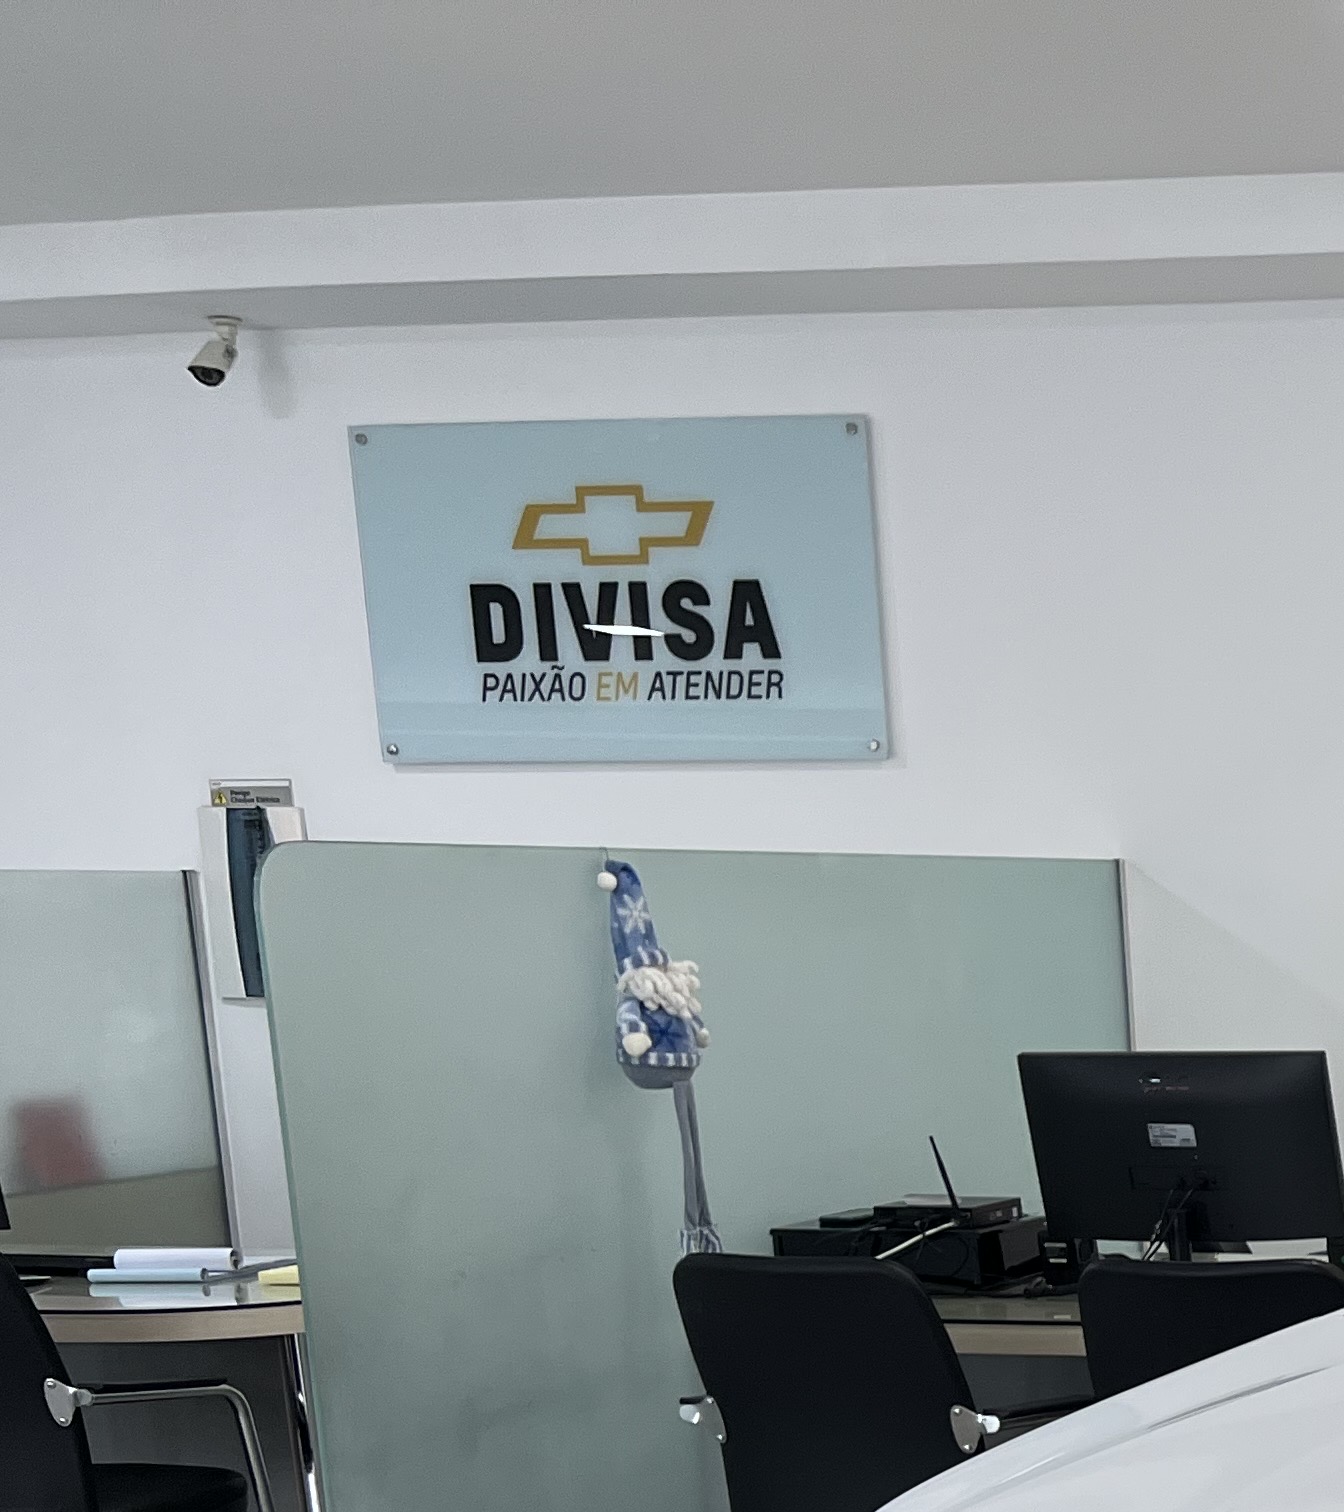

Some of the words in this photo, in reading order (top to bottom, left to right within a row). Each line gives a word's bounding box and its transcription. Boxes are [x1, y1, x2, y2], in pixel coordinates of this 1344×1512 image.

[469, 579, 782, 663] DIVISA
[481, 665, 586, 702] PAIXÃO
[596, 672, 639, 701] EM
[647, 669, 784, 701] ATENDER
